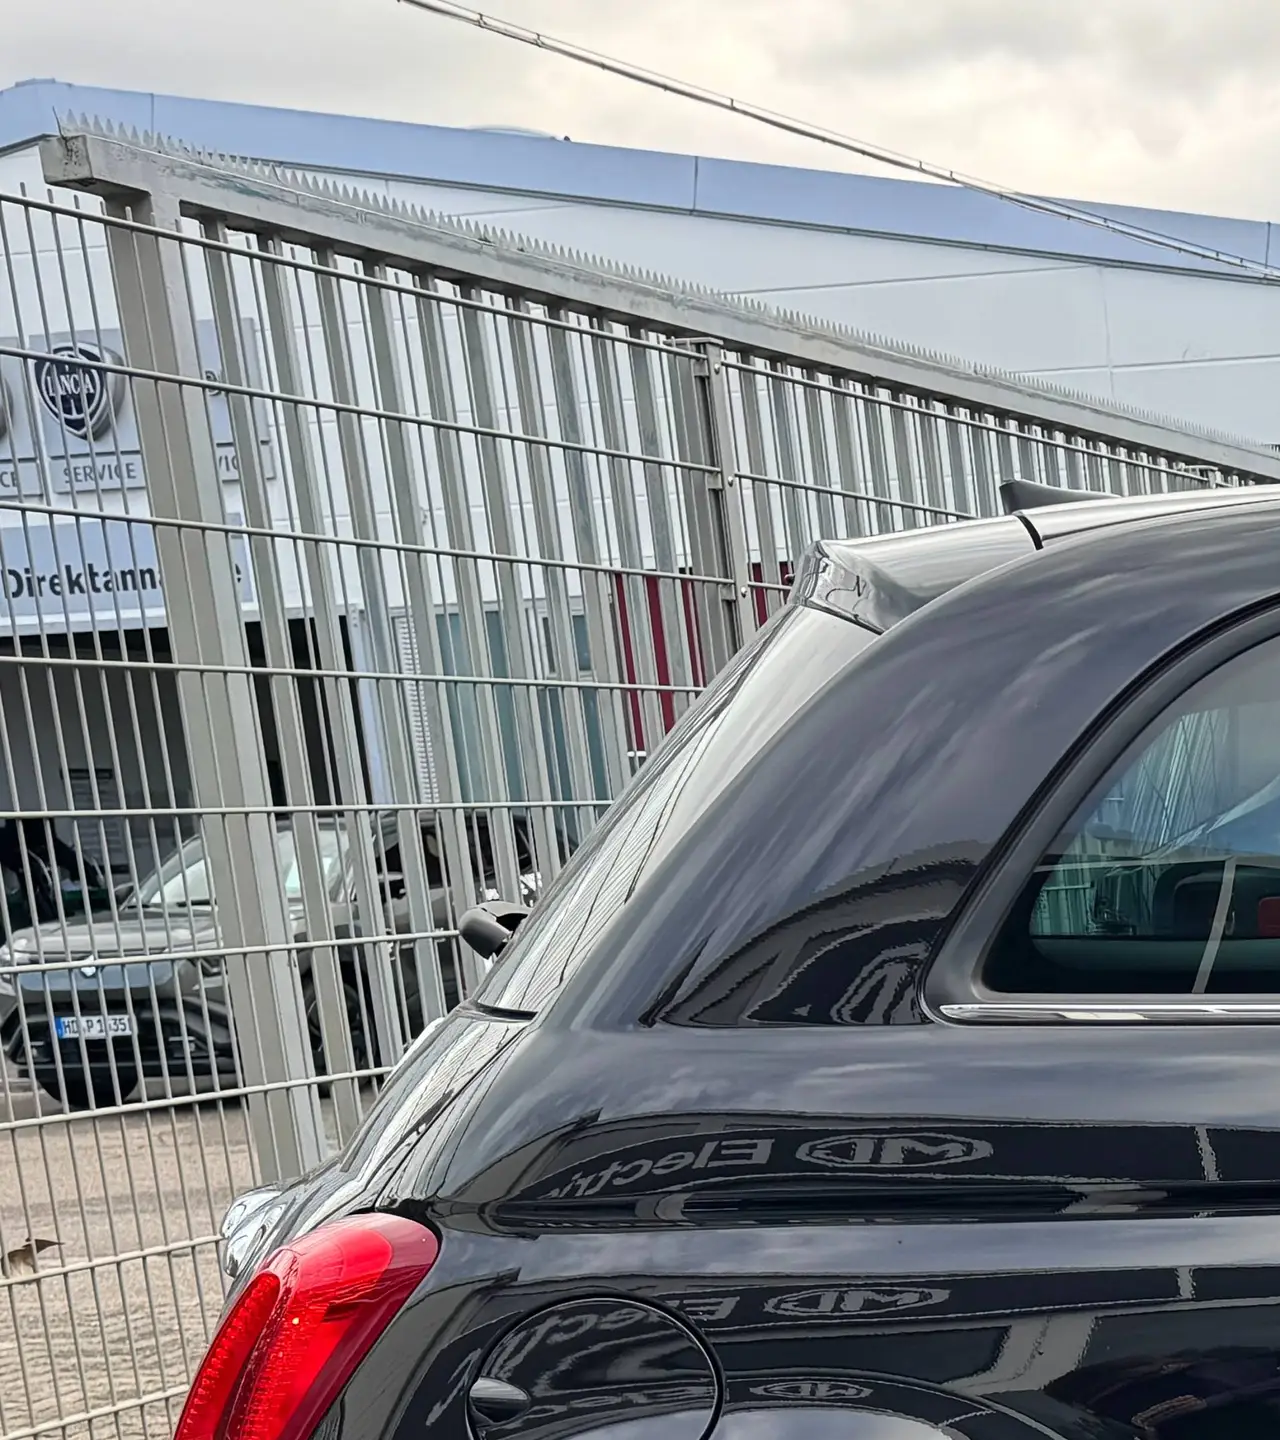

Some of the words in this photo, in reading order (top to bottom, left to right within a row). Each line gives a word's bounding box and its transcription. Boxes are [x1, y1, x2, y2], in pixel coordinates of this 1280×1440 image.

[46, 370, 95, 397] LANCA
[63, 462, 137, 484] SERVICE
[97, 1017, 127, 1033] 135
